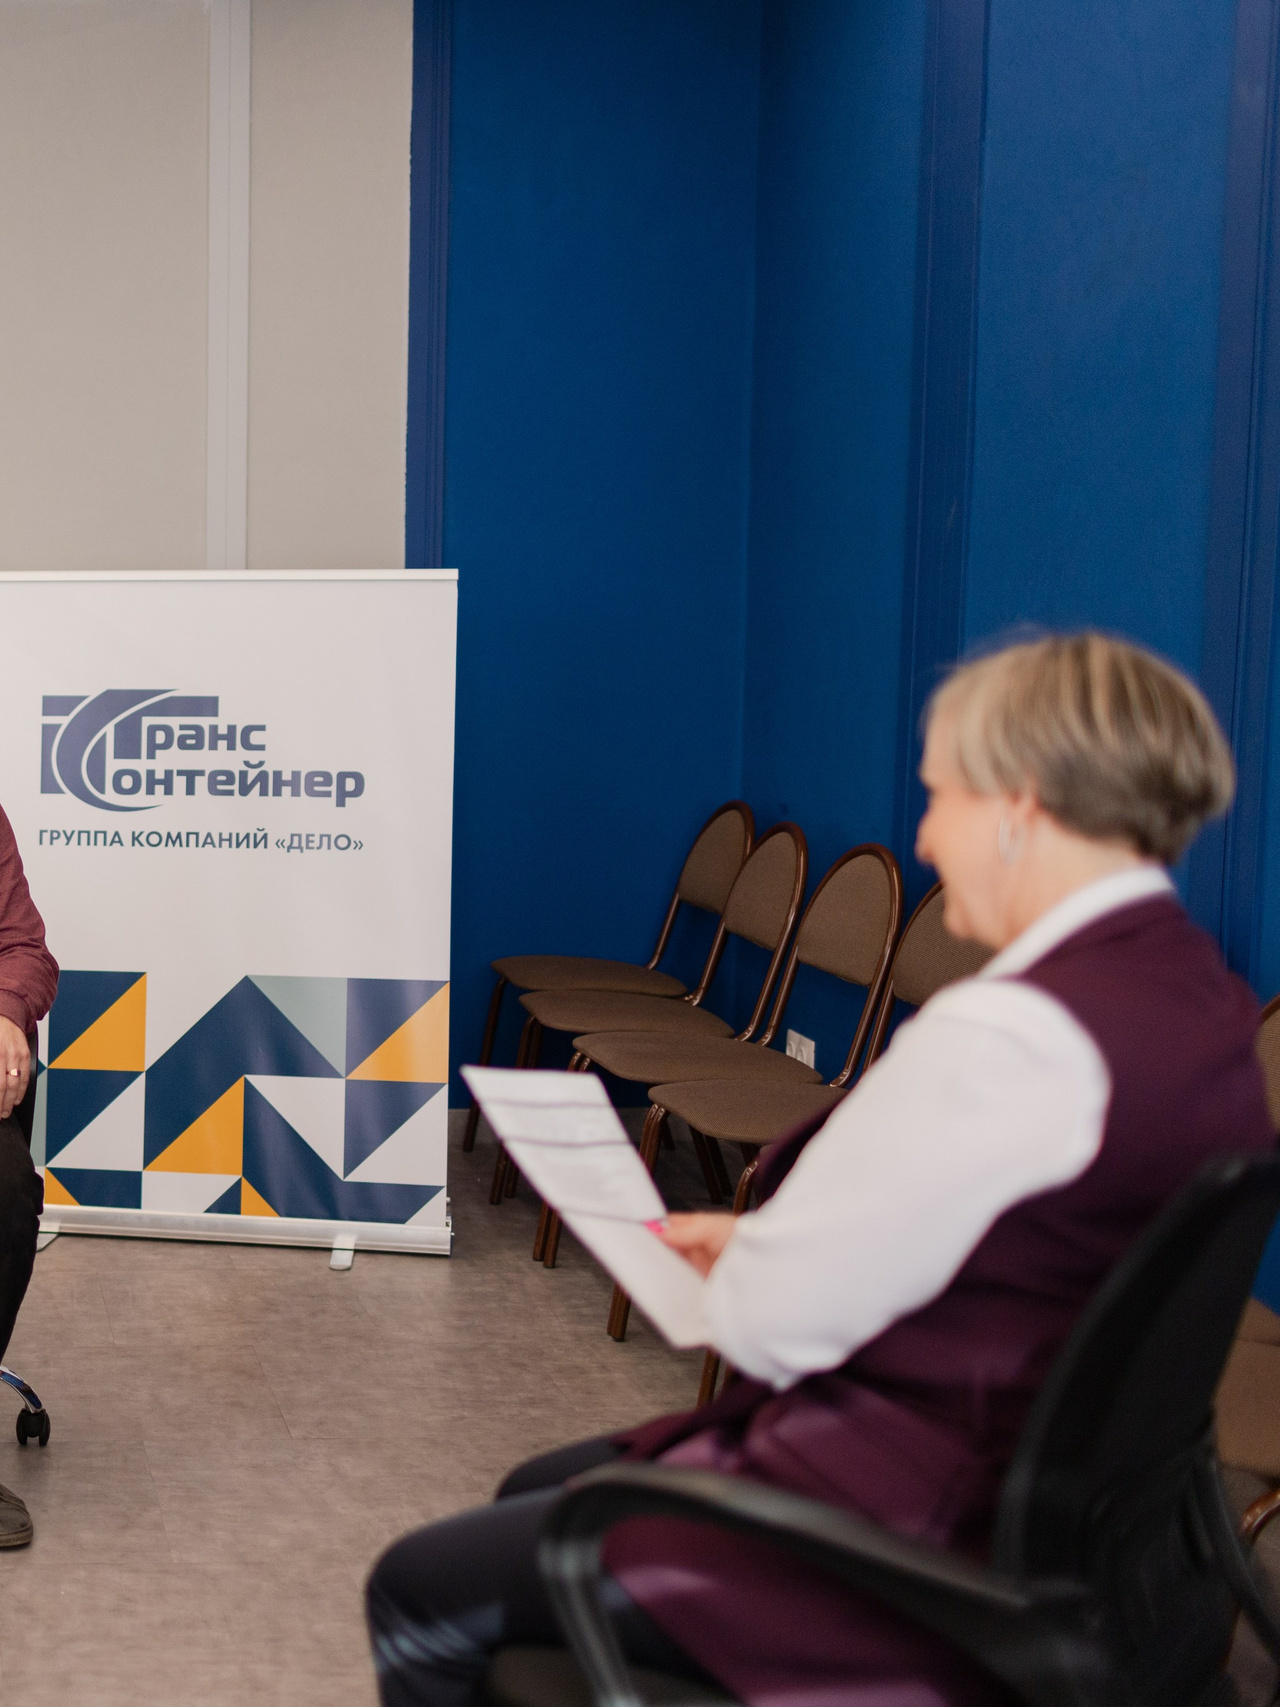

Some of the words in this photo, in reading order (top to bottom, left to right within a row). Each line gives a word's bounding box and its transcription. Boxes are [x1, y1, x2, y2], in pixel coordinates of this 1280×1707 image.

[39, 829, 124, 847] ГРУППА
[131, 828, 268, 849] КОМПАНИЙ
[275, 833, 364, 853] «ДЕЛО»
